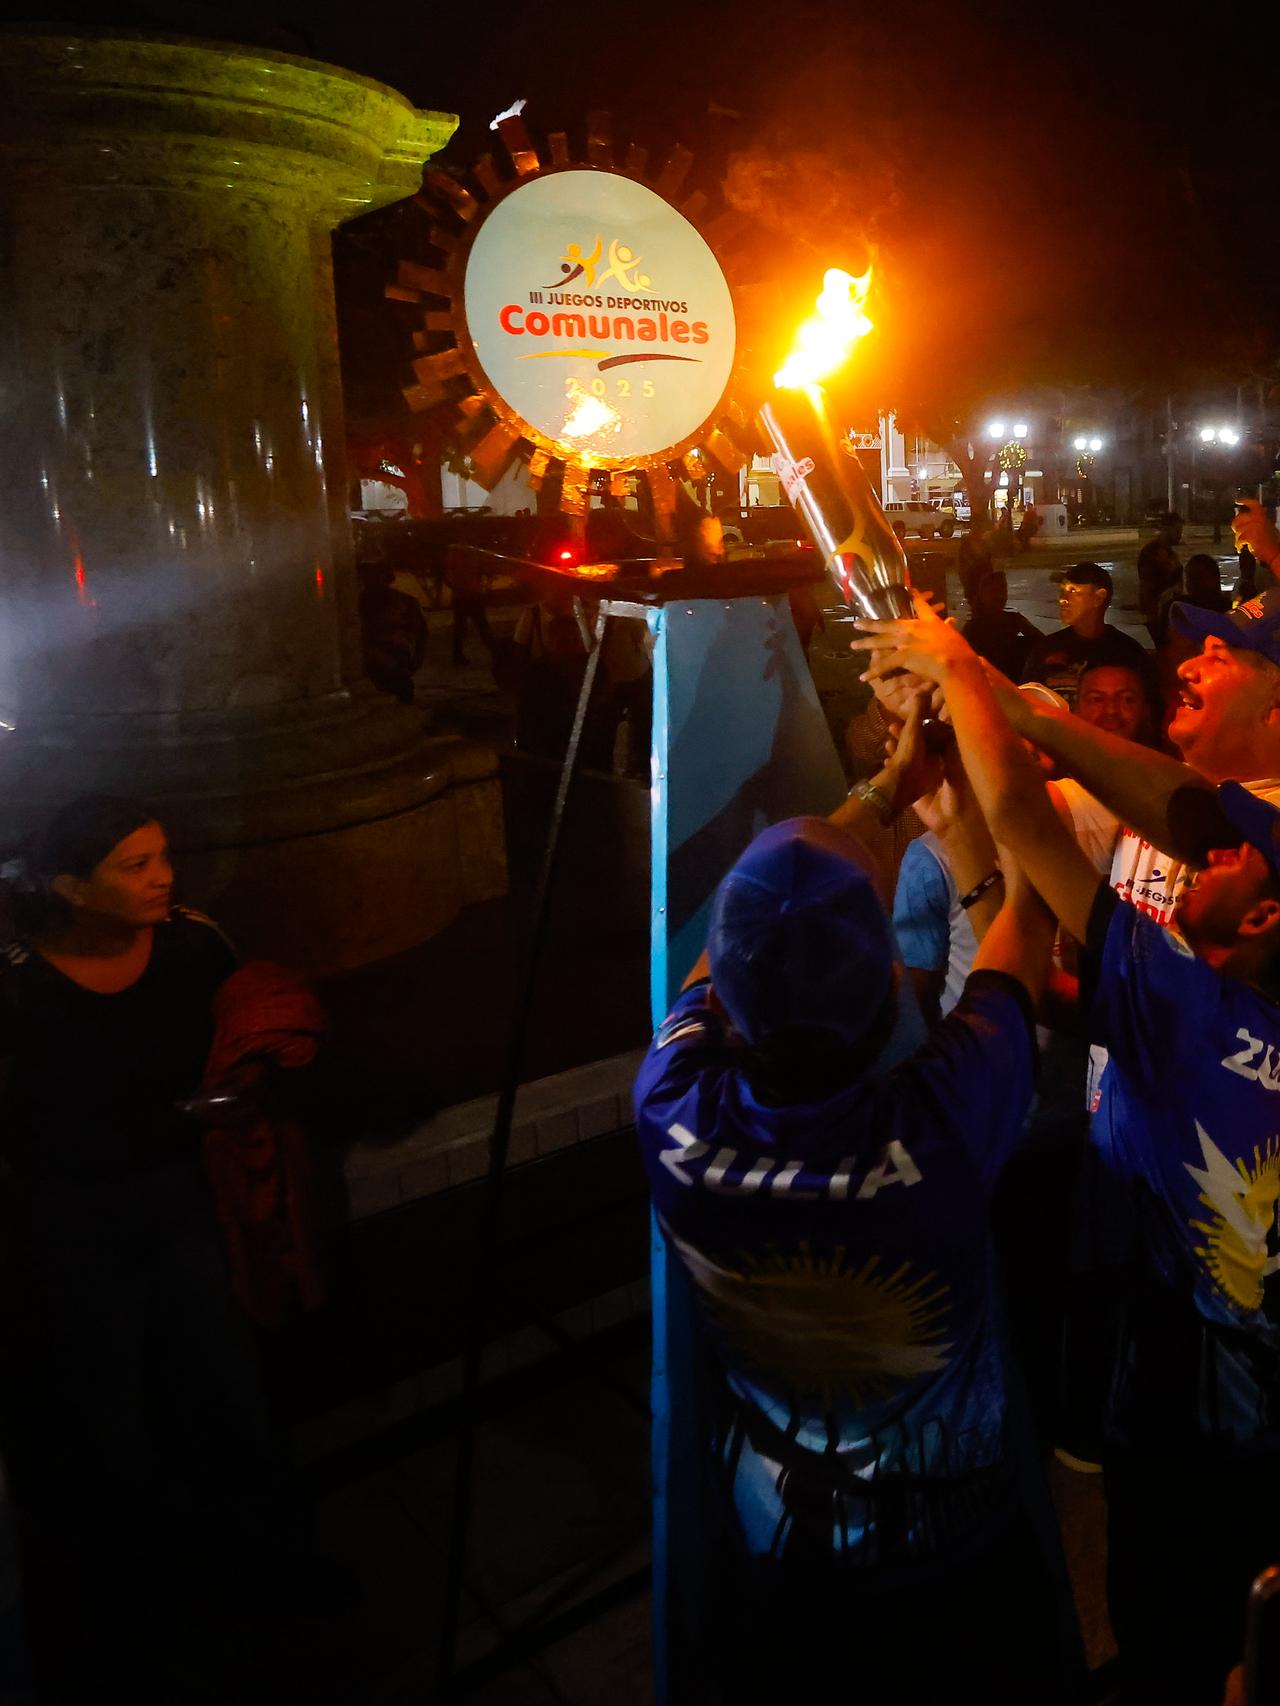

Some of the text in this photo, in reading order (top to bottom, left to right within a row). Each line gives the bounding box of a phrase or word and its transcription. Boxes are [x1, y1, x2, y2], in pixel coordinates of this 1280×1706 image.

[529, 291, 688, 313] III JUEGOS DEPORTIVOS
[499, 304, 709, 344] Comunales
[659, 1123, 923, 1201] ZULIA
